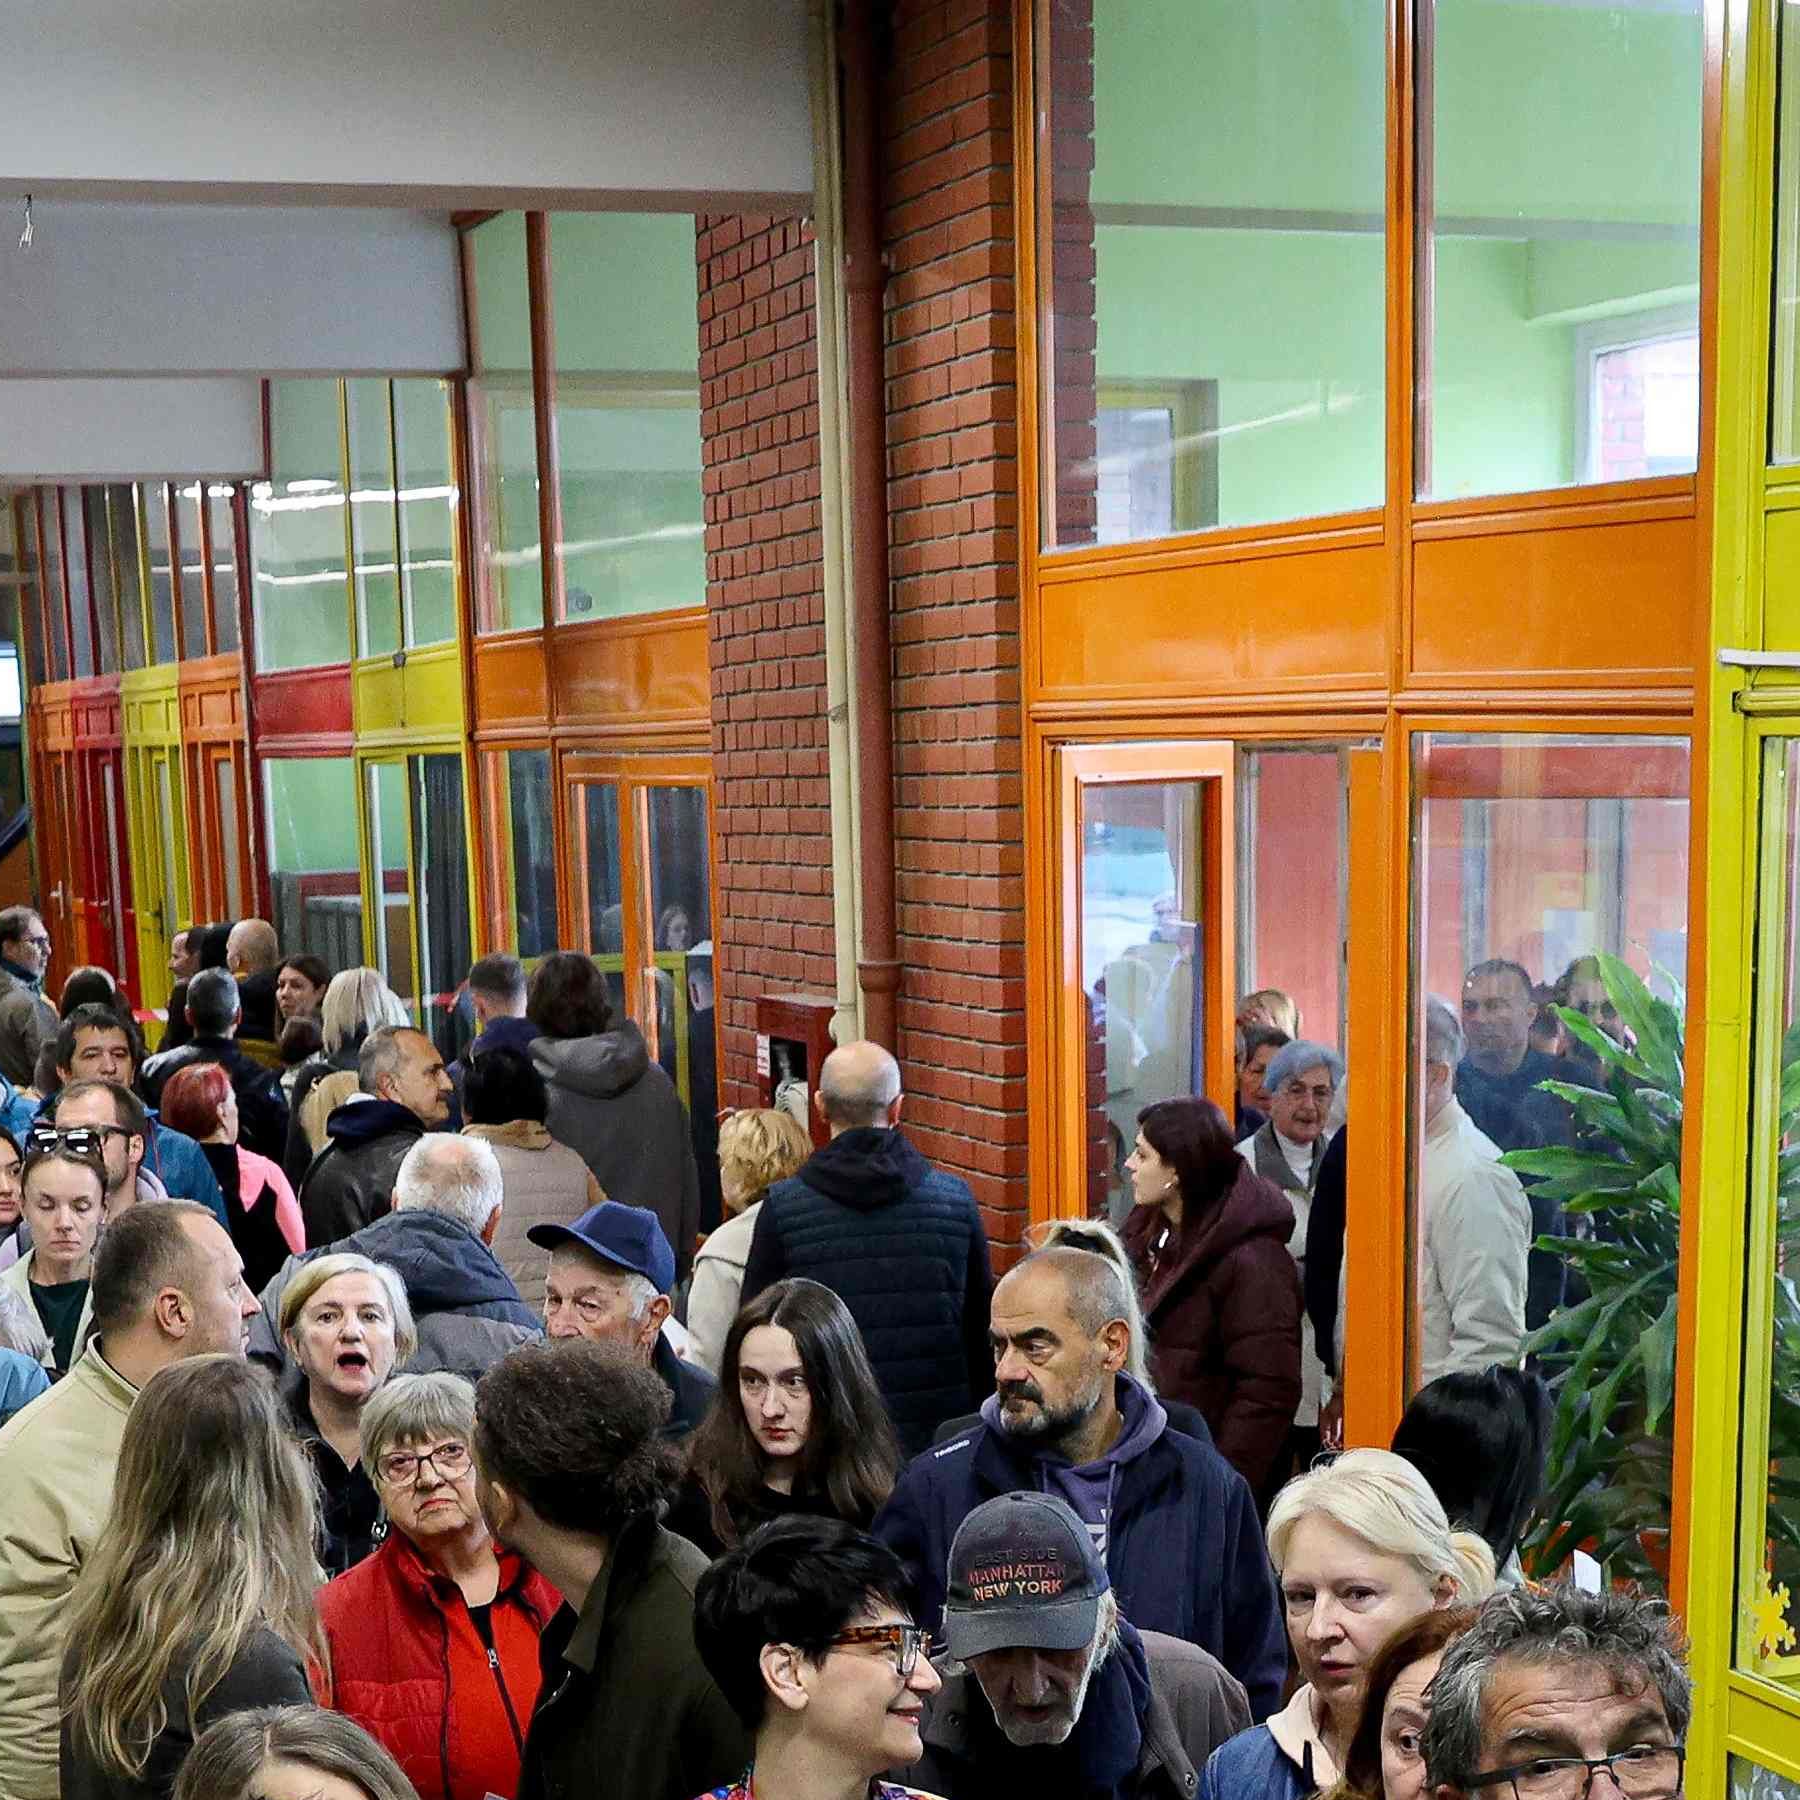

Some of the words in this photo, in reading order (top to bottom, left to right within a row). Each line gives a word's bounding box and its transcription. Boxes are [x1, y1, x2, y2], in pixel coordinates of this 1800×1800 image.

[975, 1549, 1012, 1567] EAST
[1020, 1547, 1057, 1562] SIDE
[968, 1563, 1065, 1585] MANHATTAN
[973, 1582, 1011, 1602] NEW
[1015, 1578, 1064, 1596] YORK
